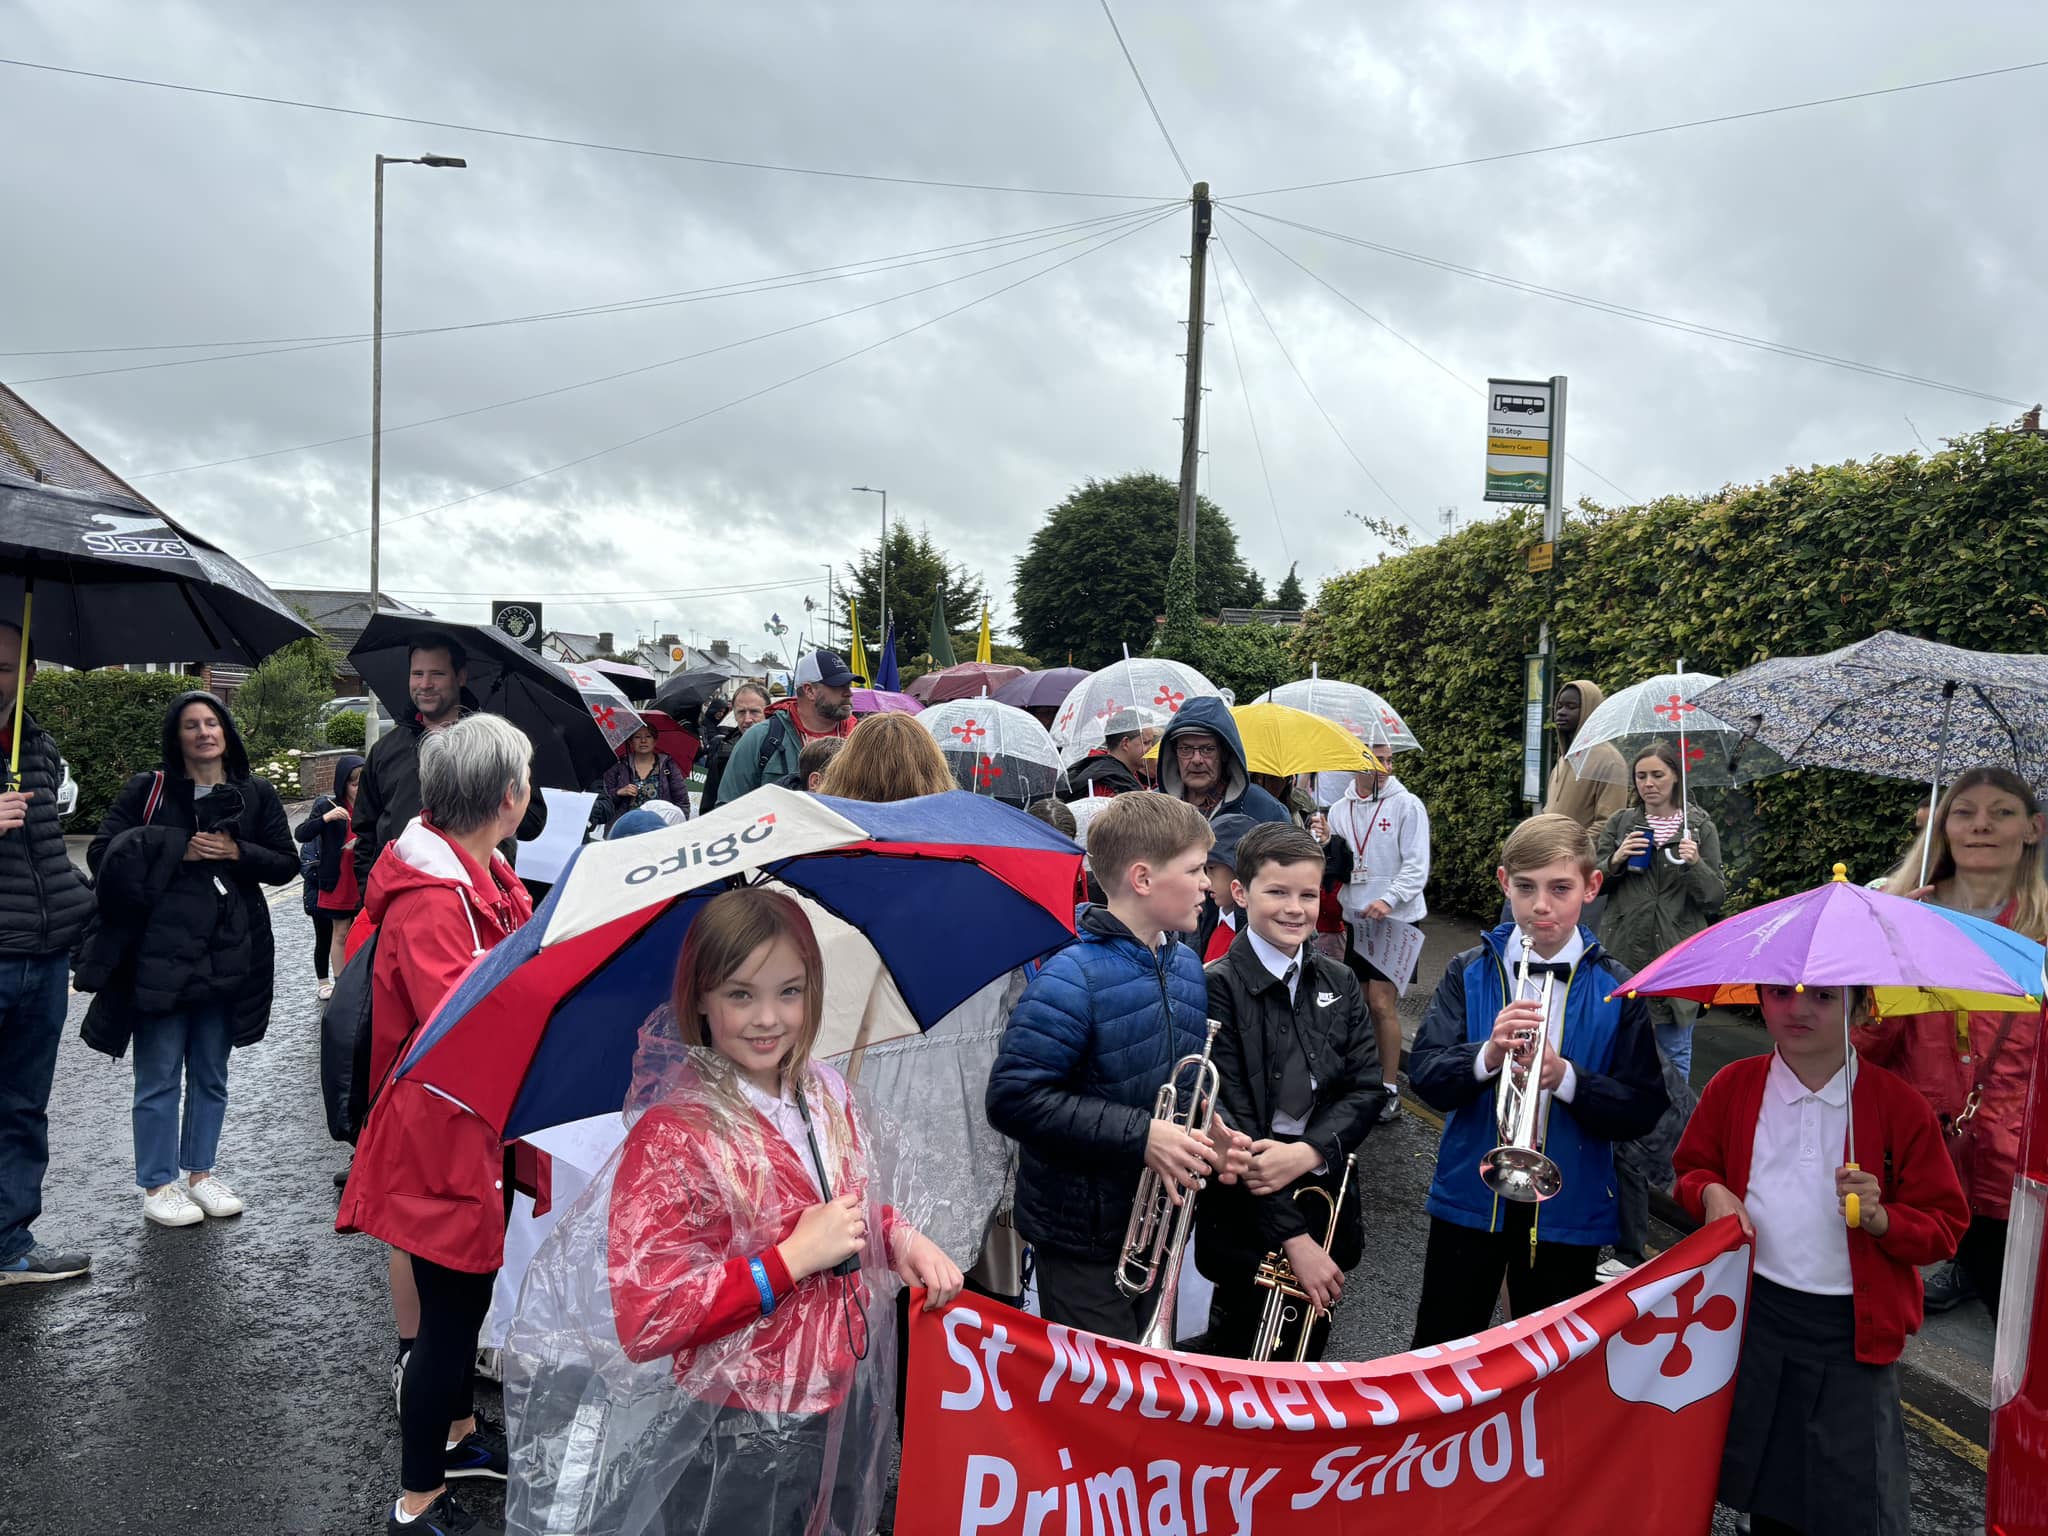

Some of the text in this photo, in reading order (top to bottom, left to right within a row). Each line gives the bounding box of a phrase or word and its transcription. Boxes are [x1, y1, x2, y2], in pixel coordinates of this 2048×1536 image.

[1492, 426, 1522, 436] Bus Stop
[624, 813, 777, 885] odigo
[940, 1306, 1017, 1412] St
[1408, 1336, 1503, 1414] CE
[958, 1386, 1546, 1536] Primary School
